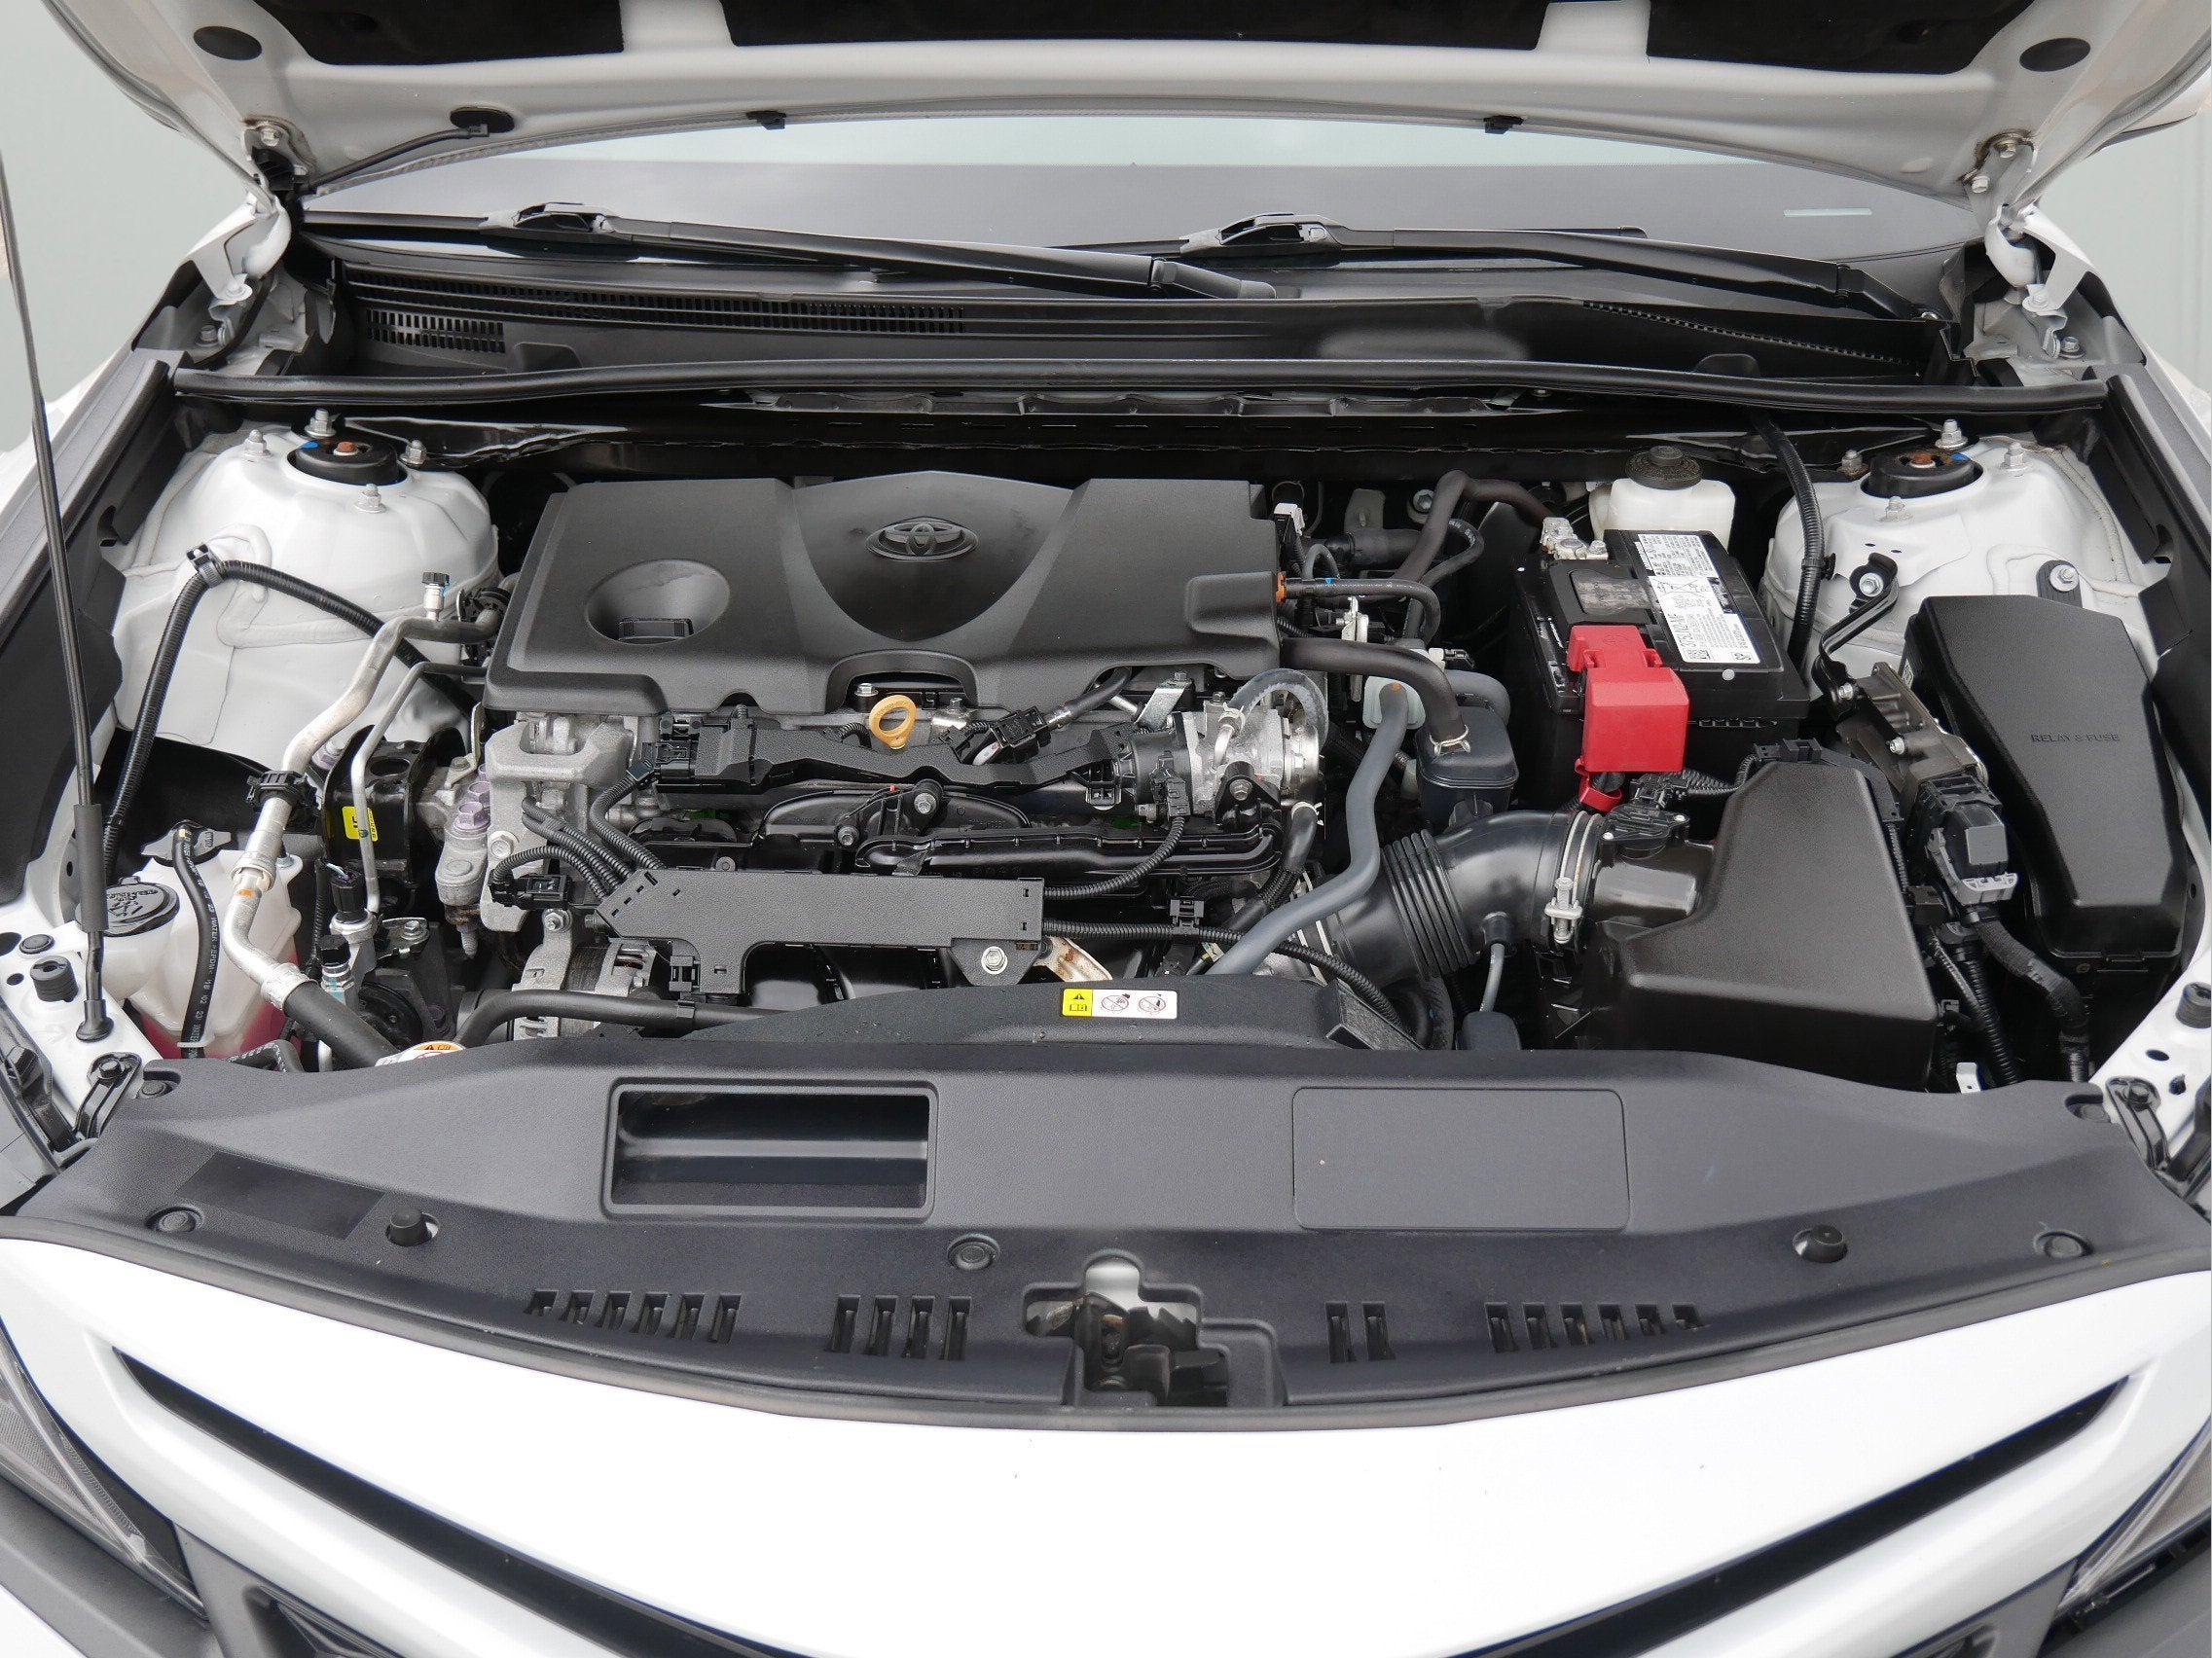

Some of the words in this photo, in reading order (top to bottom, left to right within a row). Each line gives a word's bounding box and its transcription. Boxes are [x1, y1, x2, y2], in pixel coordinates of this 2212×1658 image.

[2030, 734, 2071, 742] RELAY
[2085, 733, 2121, 742] FUSE
[210, 917, 219, 942] WATER
